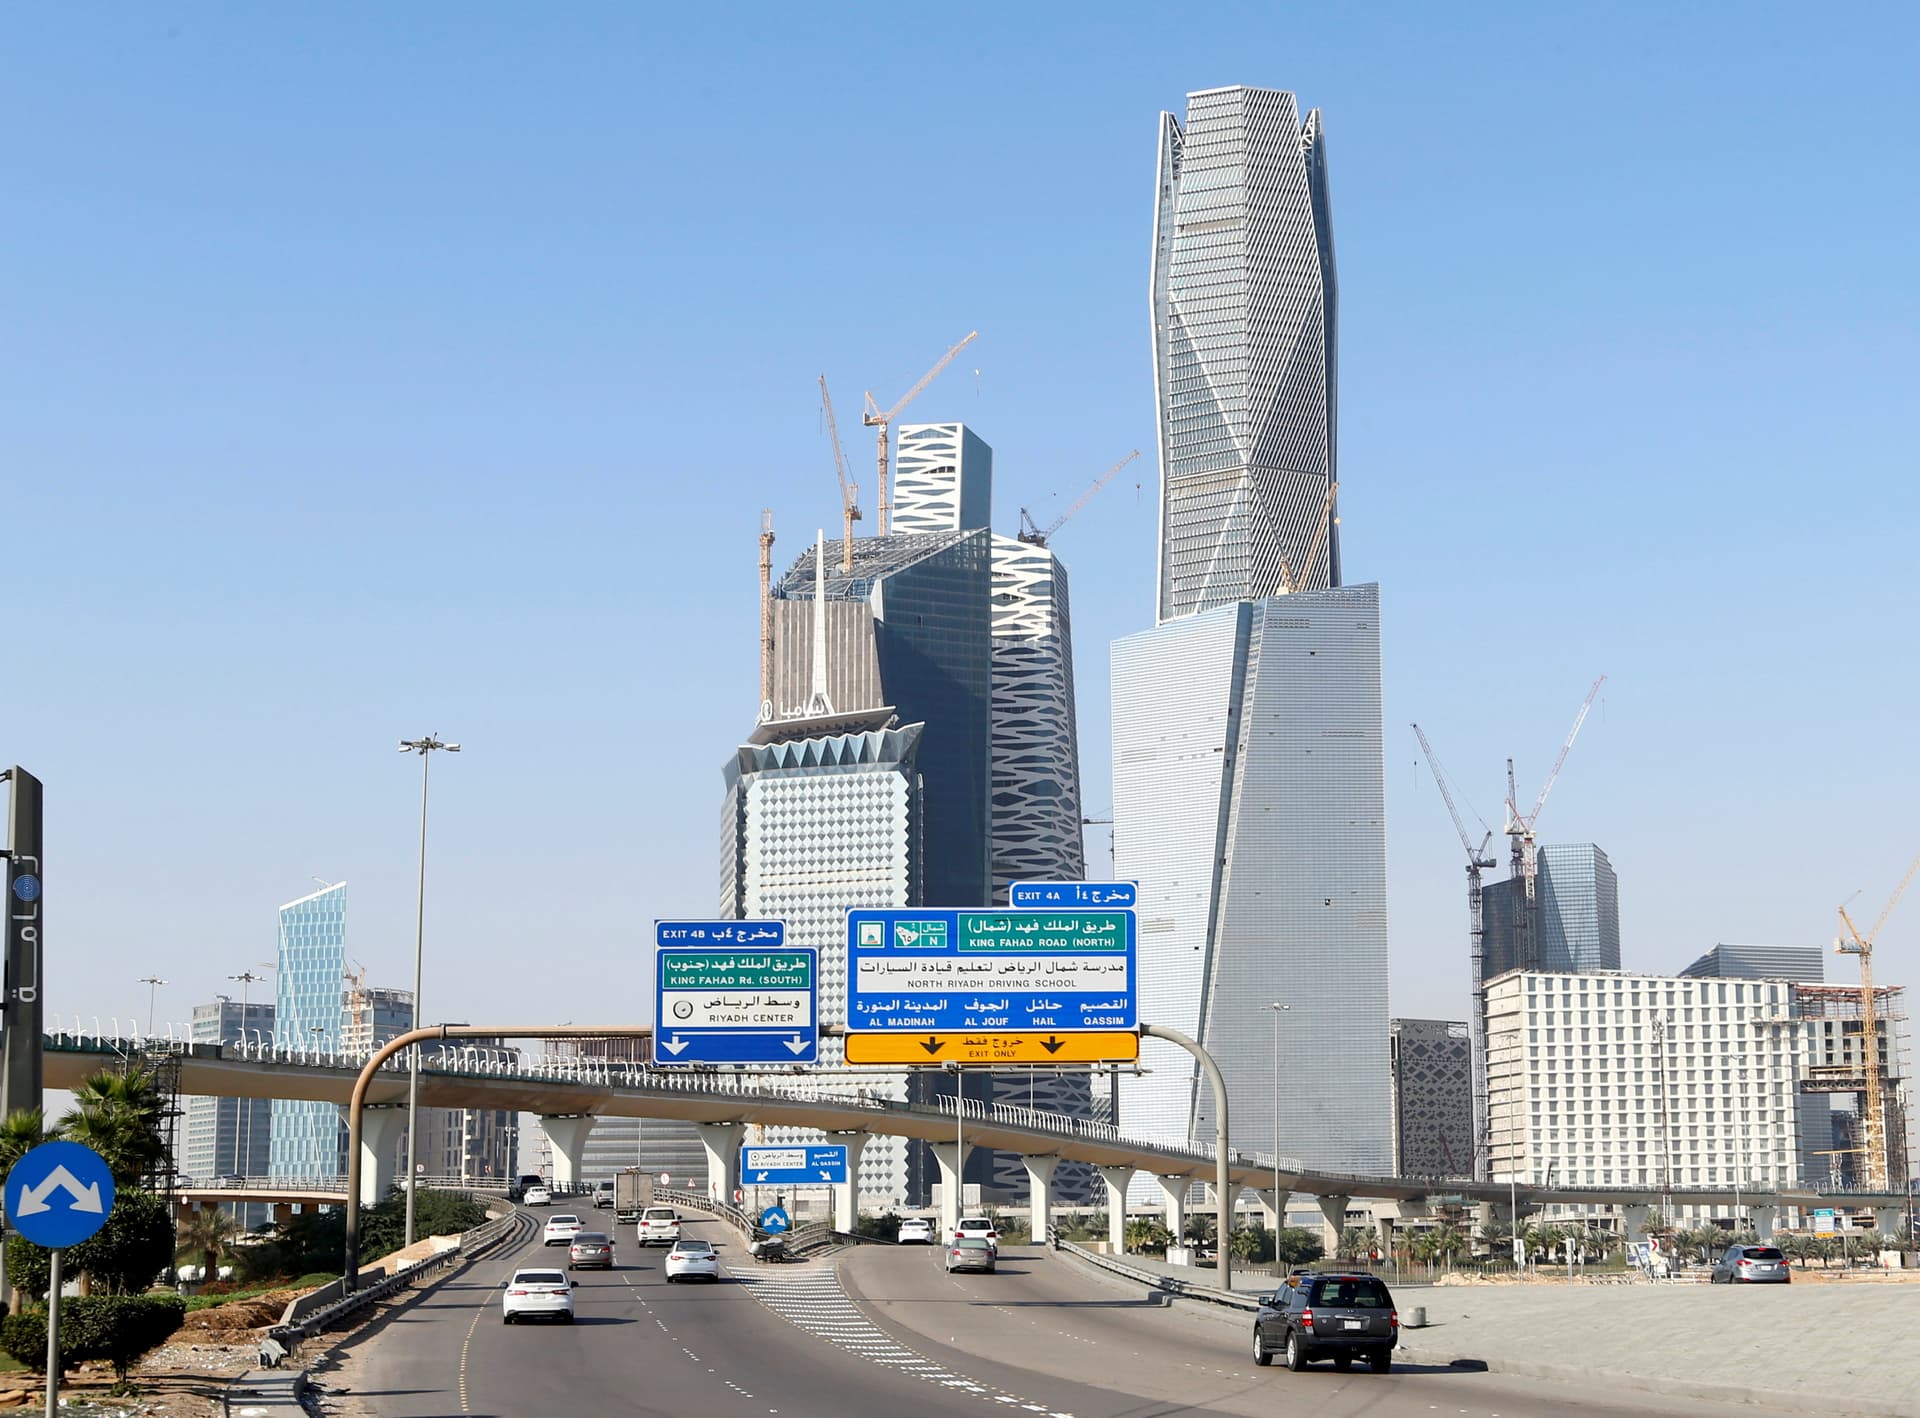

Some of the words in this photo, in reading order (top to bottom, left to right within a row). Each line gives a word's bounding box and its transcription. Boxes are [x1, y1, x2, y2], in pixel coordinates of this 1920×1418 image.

[1017, 892, 1041, 900] EXIT
[1045, 892, 1060, 900] 4A
[1092, 888, 1130, 903] مخرج
[968, 918, 1012, 934] (شمال)
[1015, 919, 1039, 931] فهد
[1043, 919, 1079, 931] الملك
[1082, 920, 1116, 934] طريق
[662, 930, 688, 939] EXIT
[690, 930, 706, 938] 4B
[736, 928, 778, 942] مخرج
[929, 936, 938, 945] N
[969, 938, 995, 947] KING
[1000, 938, 1034, 947] FAHAD
[1038, 938, 1068, 947] ROAD
[1072, 937, 1115, 948] (NORTH)
[666, 959, 710, 972] (جنوب)
[711, 956, 735, 971] فهد
[737, 957, 771, 969] الملك
[772, 957, 806, 972] طريق
[860, 961, 917, 975] السيارات
[921, 961, 952, 974] قيادة
[956, 962, 993, 974] لتعليم
[998, 962, 1041, 974] الرياض
[1045, 961, 1078, 974] شمال
[1083, 962, 1124, 974] مدرسة
[670, 976, 696, 985] KING
[699, 976, 735, 985] FAHAD
[739, 976, 755, 985] Rd.
[759, 975, 803, 985] (SOUTH)
[907, 980, 943, 988] NORTH
[947, 980, 984, 988] RIYADH
[989, 979, 1030, 987] DRIVING
[1035, 979, 1077, 987] SCHOOL
[703, 996, 760, 1009] الرياض
[764, 996, 801, 1009] وسط
[856, 999, 900, 1013] المنورة
[904, 999, 947, 1012] المدينة
[964, 998, 1009, 1013] الجوف
[1025, 999, 1063, 1013] حائل
[1080, 999, 1127, 1013] القصيم
[709, 1014, 749, 1023] RIYADH
[753, 1014, 794, 1023] CENTER
[869, 1018, 882, 1026] AL
[887, 1018, 935, 1026] MADINAH
[964, 1018, 978, 1026] AL
[982, 1017, 1009, 1026] JOUF
[1032, 1017, 1056, 1026] HAIL
[1083, 1017, 1124, 1025] QASSIM
[962, 1036, 988, 1046] فقط
[992, 1037, 1024, 1048] خروج
[968, 1050, 989, 1058] EXIT
[993, 1050, 1017, 1058] ONLY
